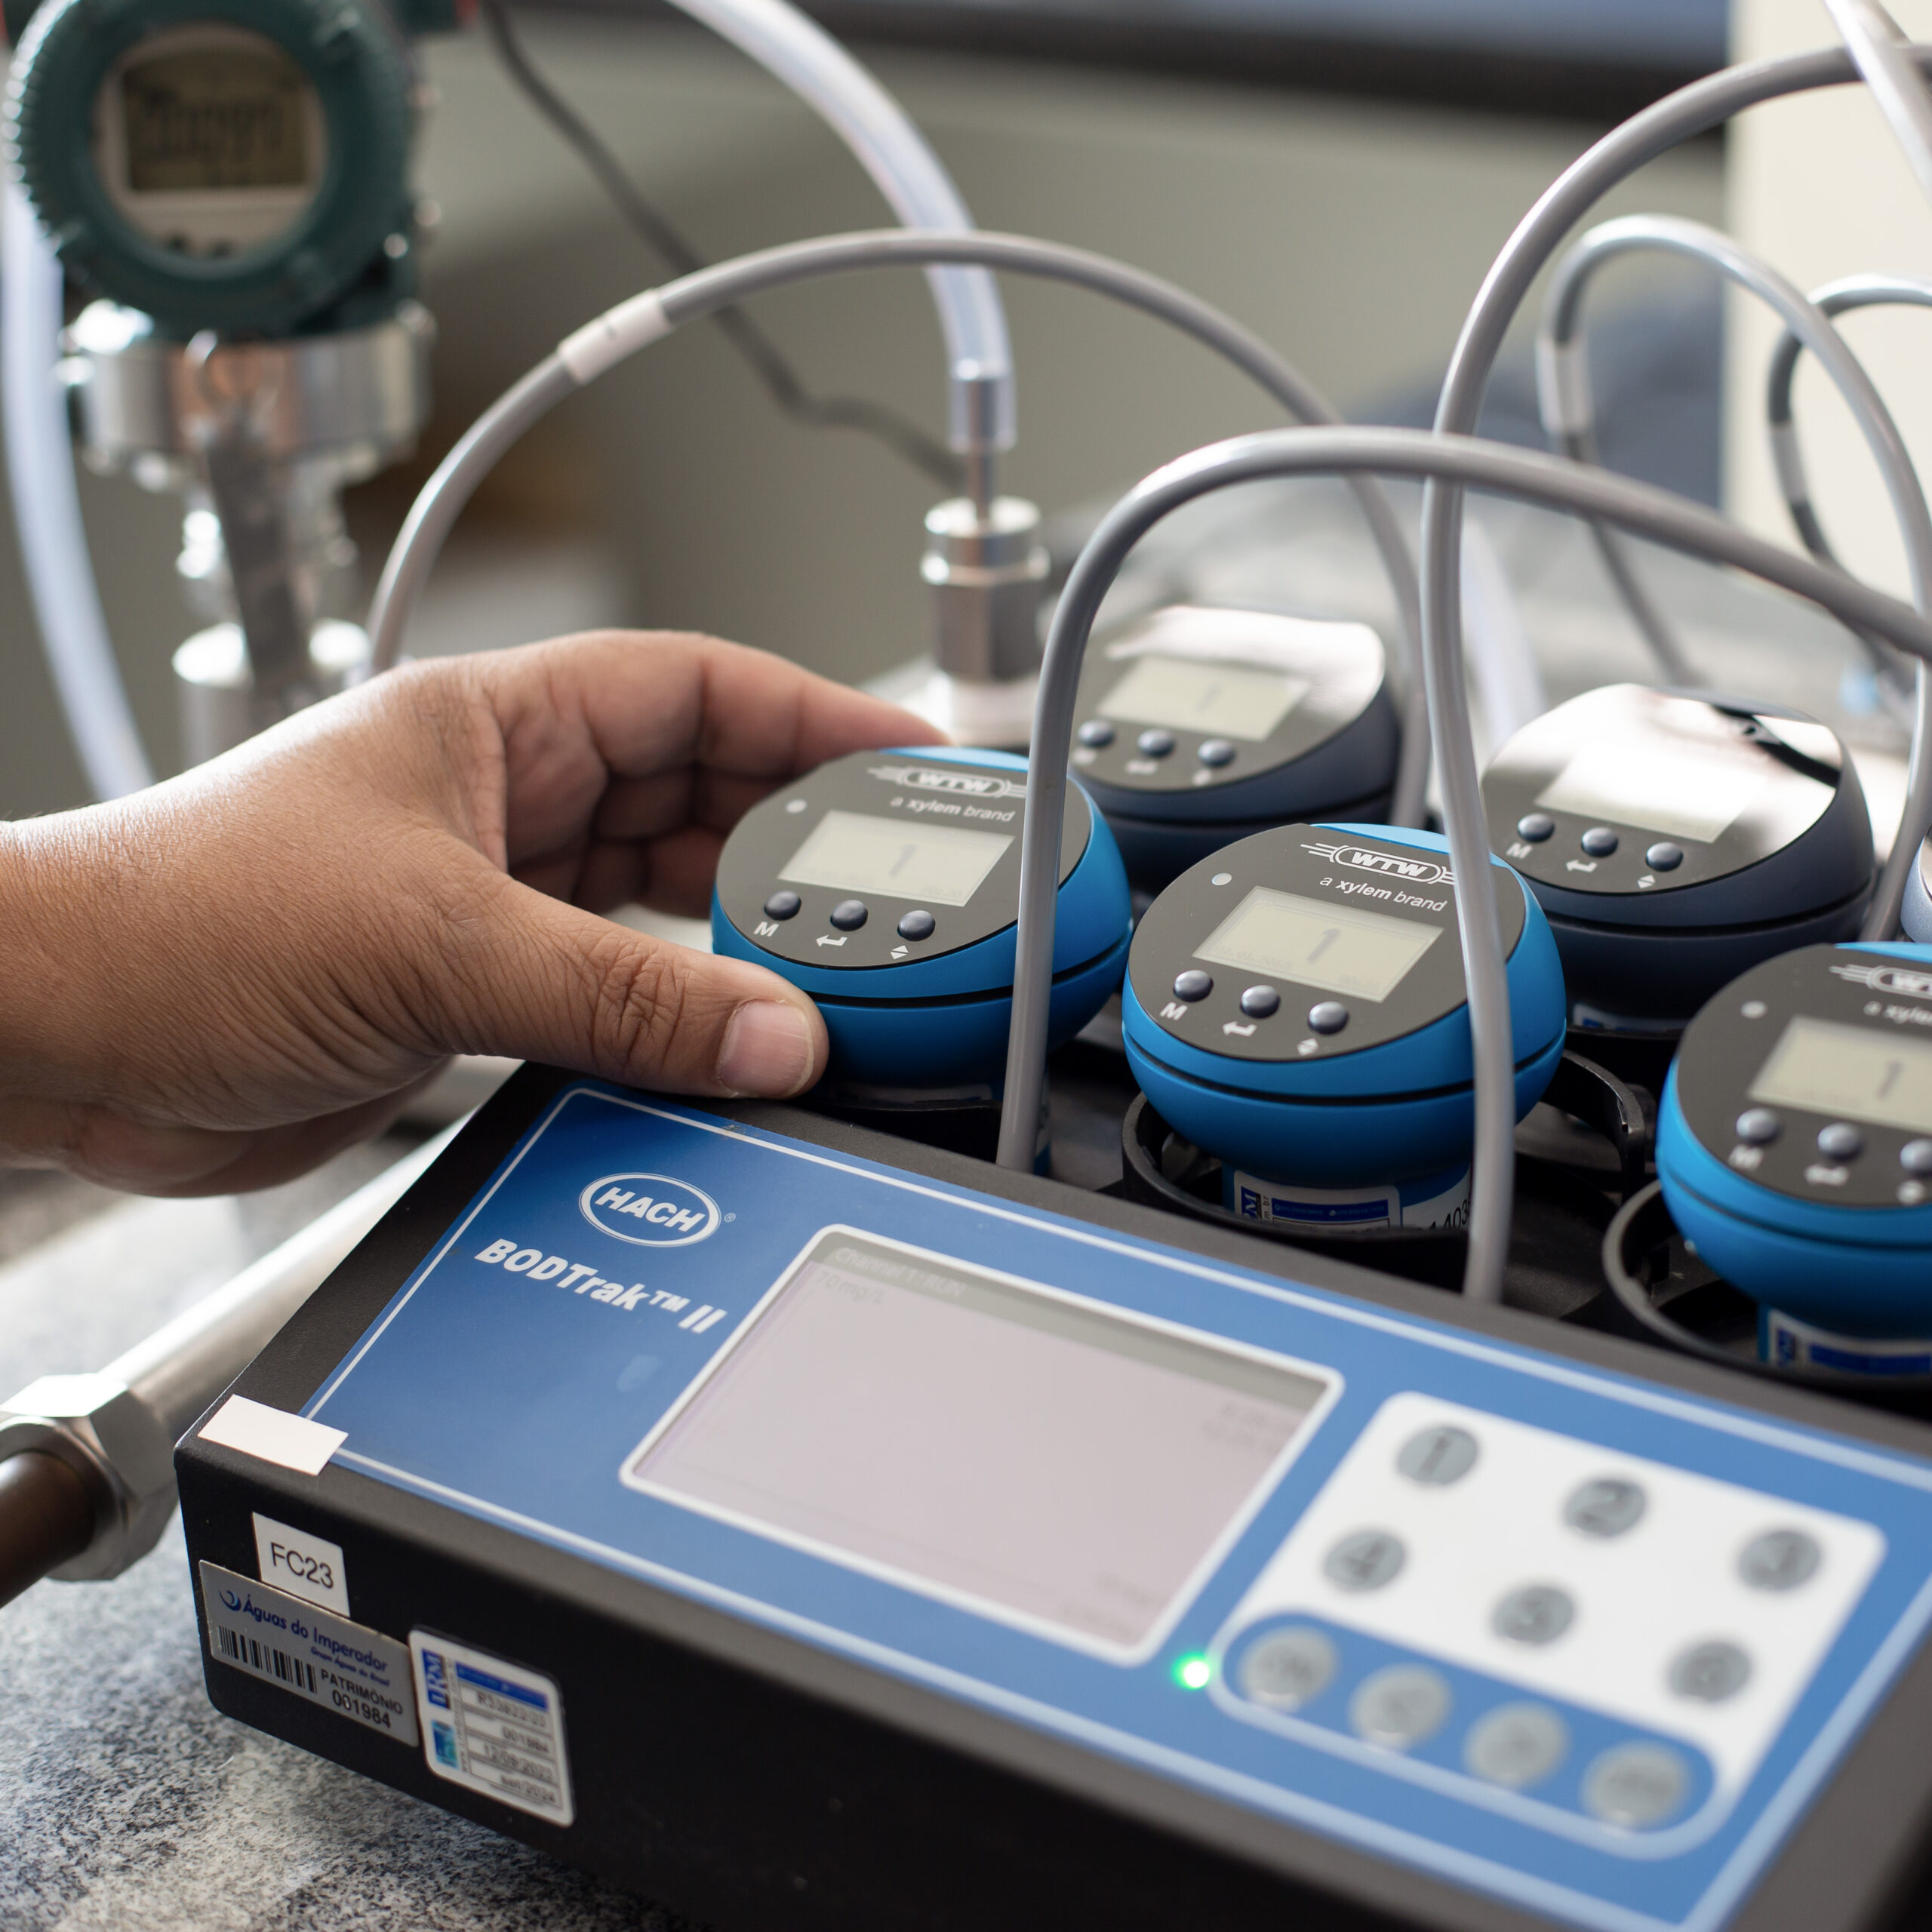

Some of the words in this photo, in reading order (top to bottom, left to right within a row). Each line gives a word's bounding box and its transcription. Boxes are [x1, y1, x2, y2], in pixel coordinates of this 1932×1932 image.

[918, 771, 992, 793] WTW
[891, 797, 903, 808] a
[907, 797, 961, 816] xylem
[964, 804, 1016, 823] brand
[888, 844, 918, 879] 1
[1350, 851, 1429, 878] WTW
[1506, 842, 1533, 860] M
[1320, 875, 1333, 888] a
[1336, 877, 1392, 901] xylem
[1393, 891, 1447, 912] brand
[754, 921, 779, 937] M
[1306, 928, 1343, 966] 1
[1159, 1001, 1188, 1021] M
[595, 1186, 706, 1232] HACH
[270, 1541, 334, 1589] FC23
[242, 1594, 288, 1629] Águas
[291, 1620, 309, 1639] do
[313, 1627, 388, 1672] Imperador
[321, 1668, 403, 1715] PATRIMÔNIO
[332, 1689, 392, 1729] 001984
